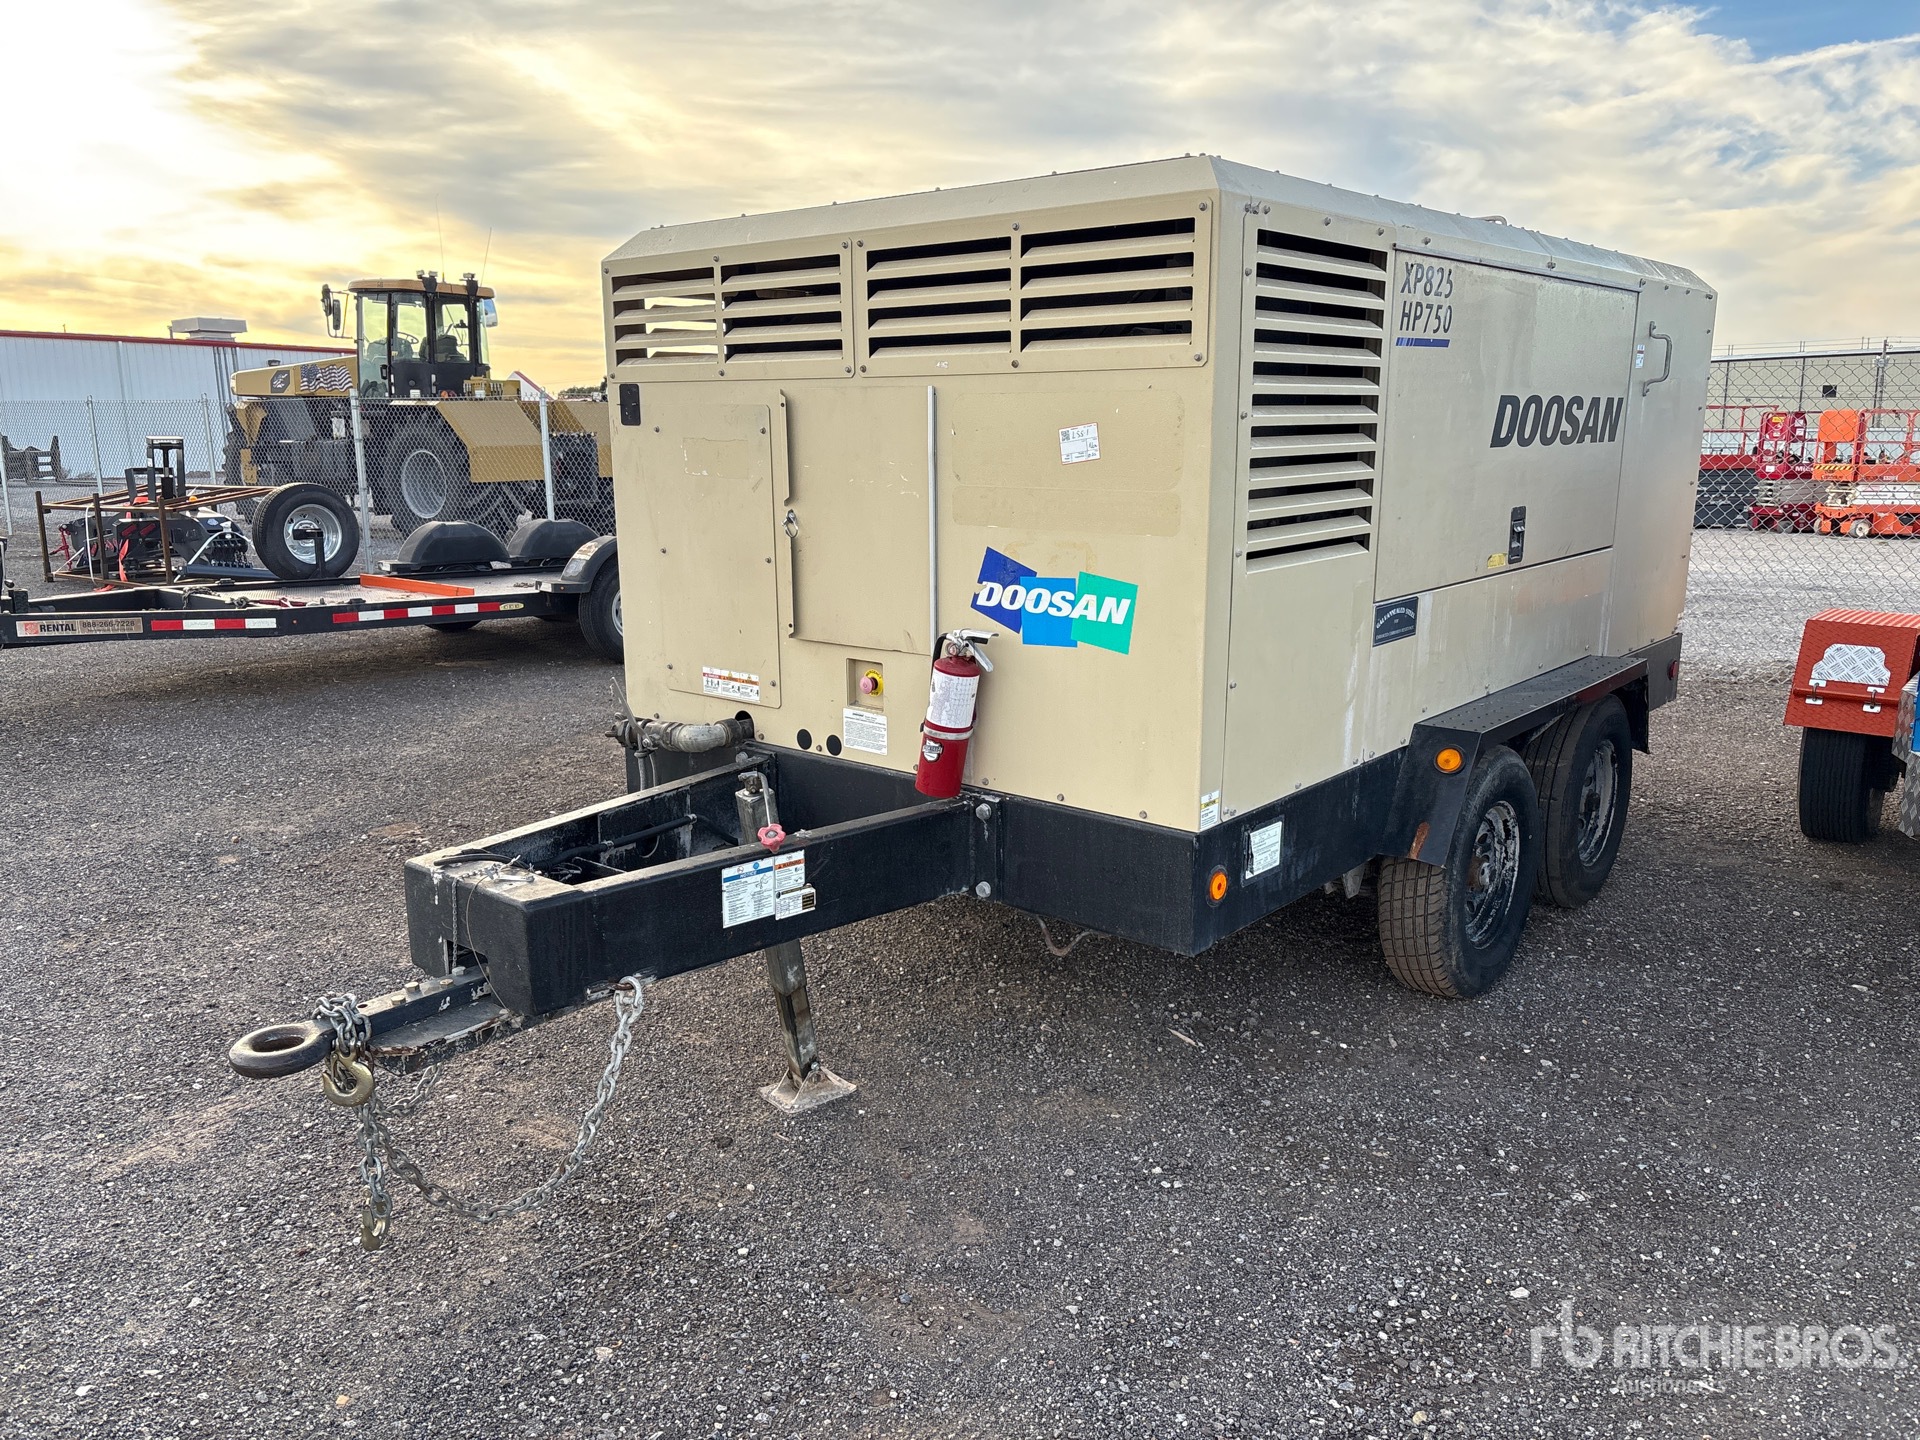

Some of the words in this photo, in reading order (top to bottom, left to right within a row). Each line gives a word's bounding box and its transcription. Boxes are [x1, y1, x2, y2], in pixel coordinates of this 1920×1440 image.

[1400, 261, 1453, 299] XP825
[1399, 300, 1453, 334] HP750
[1489, 394, 1624, 448] DOOSAN
[975, 580, 1132, 625] DOOSAN
[39, 622, 77, 633] RENTAL
